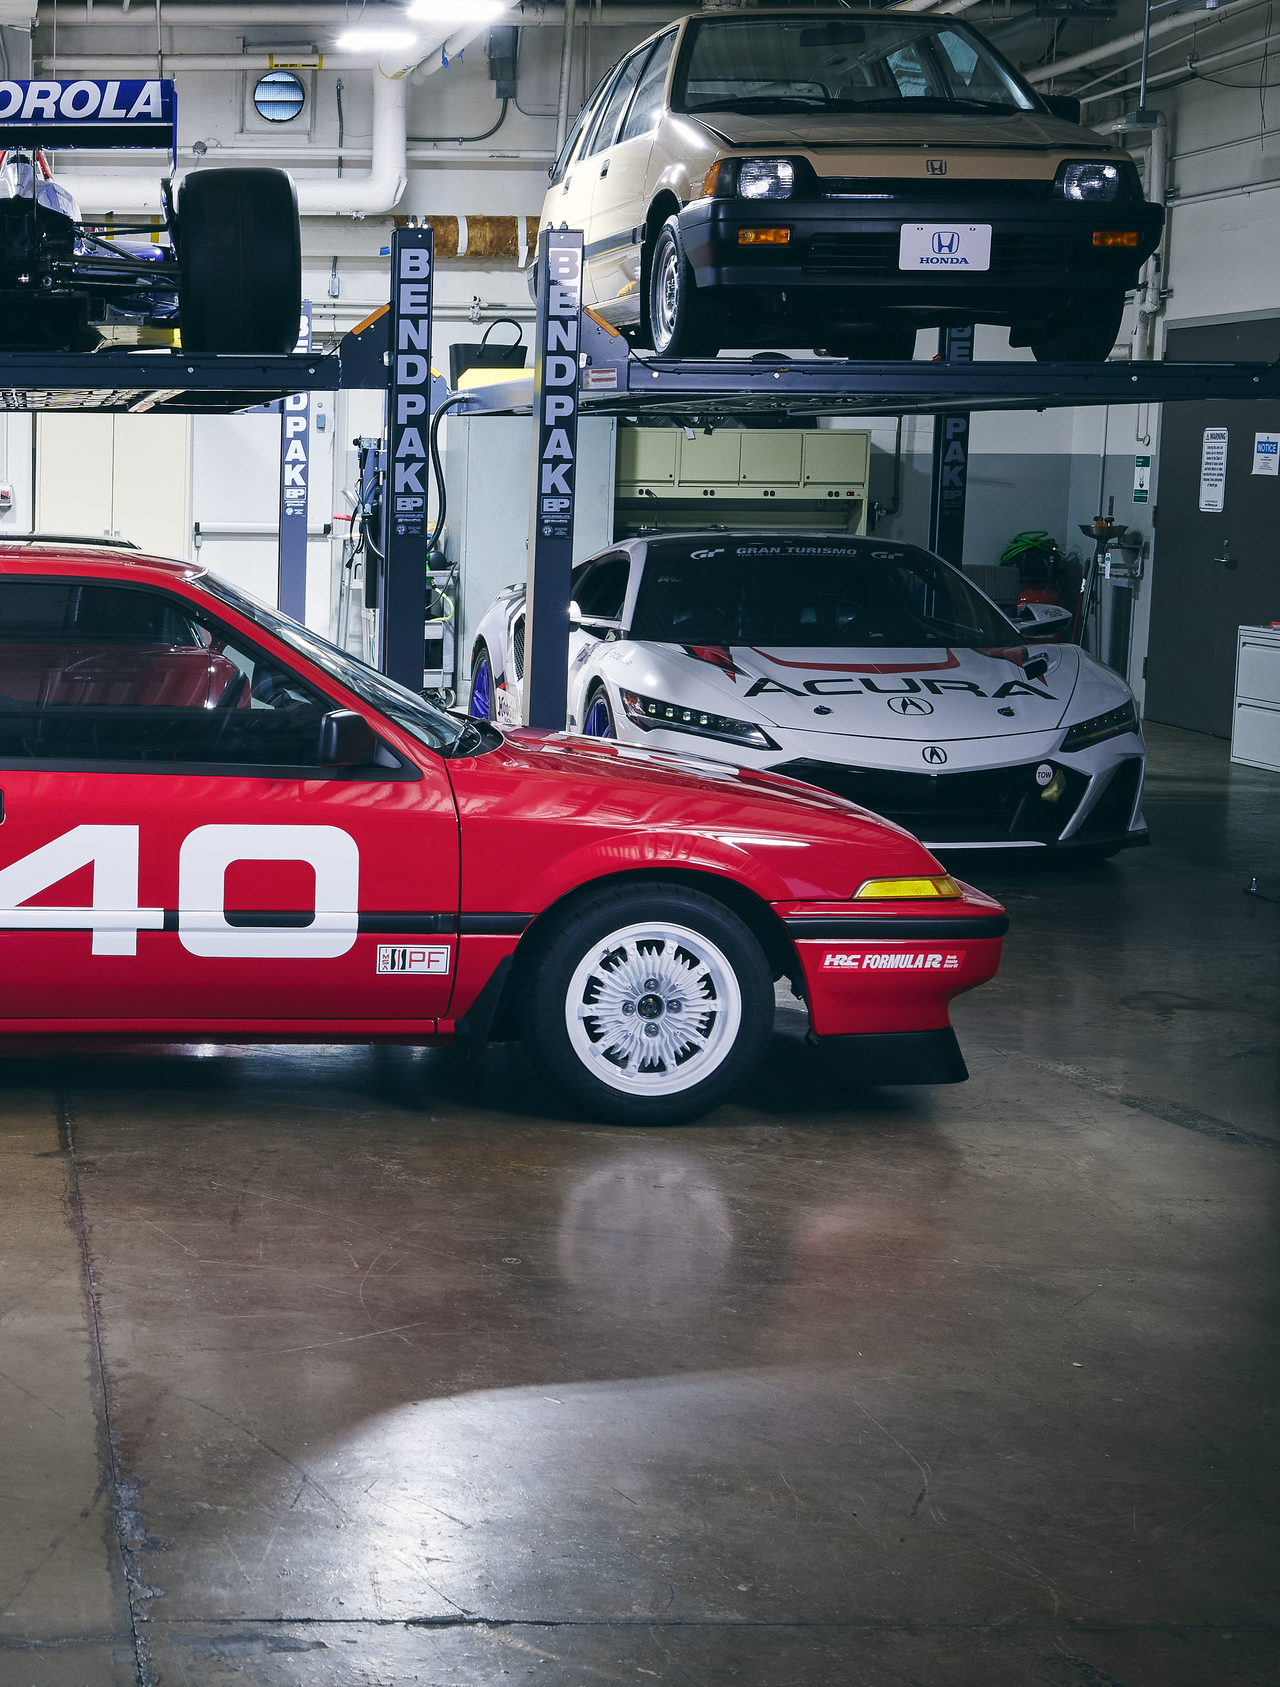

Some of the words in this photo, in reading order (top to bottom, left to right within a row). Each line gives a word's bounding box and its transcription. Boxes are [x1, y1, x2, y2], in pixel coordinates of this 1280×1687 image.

[919, 257, 970, 265] HONDA
[395, 247, 430, 493] BENDPAK
[542, 249, 580, 494] BENDPAK
[1257, 443, 1277, 453] NOTICE
[786, 547, 858, 555] TURISMO
[743, 677, 1060, 700] ACURA
[1037, 771, 1052, 779] TOW
[408, 951, 445, 969] PF
[823, 954, 862, 966] HRC
[861, 954, 924, 969] FORMULA
